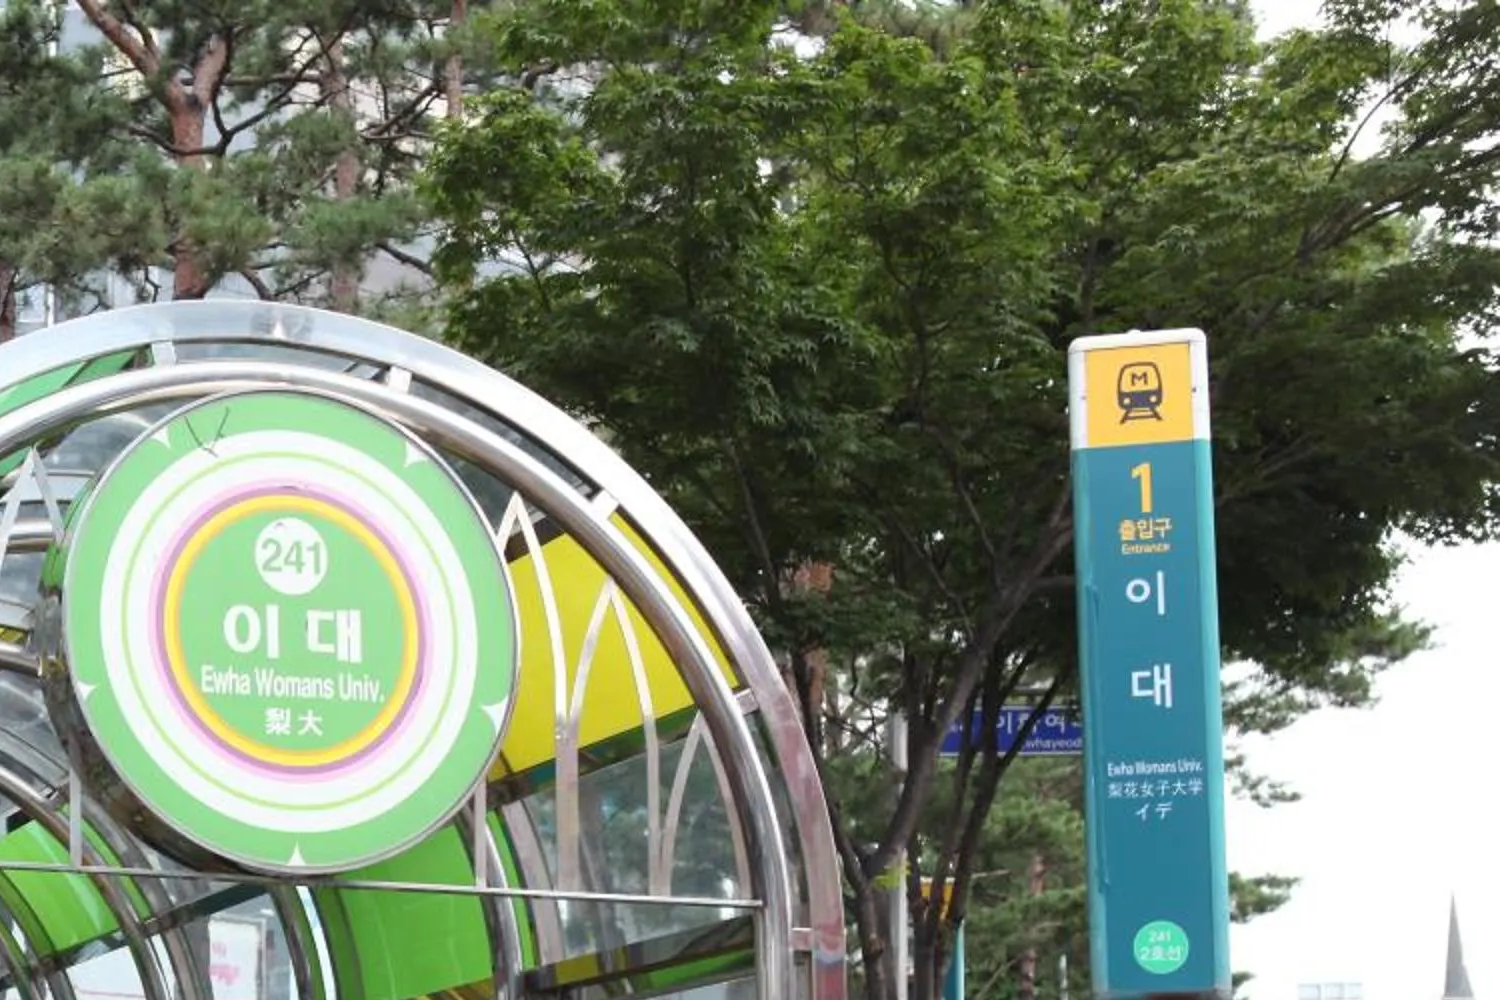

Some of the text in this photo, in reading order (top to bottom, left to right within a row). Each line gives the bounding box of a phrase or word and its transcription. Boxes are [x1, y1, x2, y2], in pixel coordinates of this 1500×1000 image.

[1131, 462, 1152, 513] 1
[1119, 517, 1172, 541] 출입구
[261, 538, 321, 575] 241
[1121, 543, 1171, 555] Entrance
[200, 664, 386, 704] Ewha Womans Univ.
[1107, 757, 1204, 777] Ewha Womans Univ.
[1135, 801, 1173, 821] イデ
